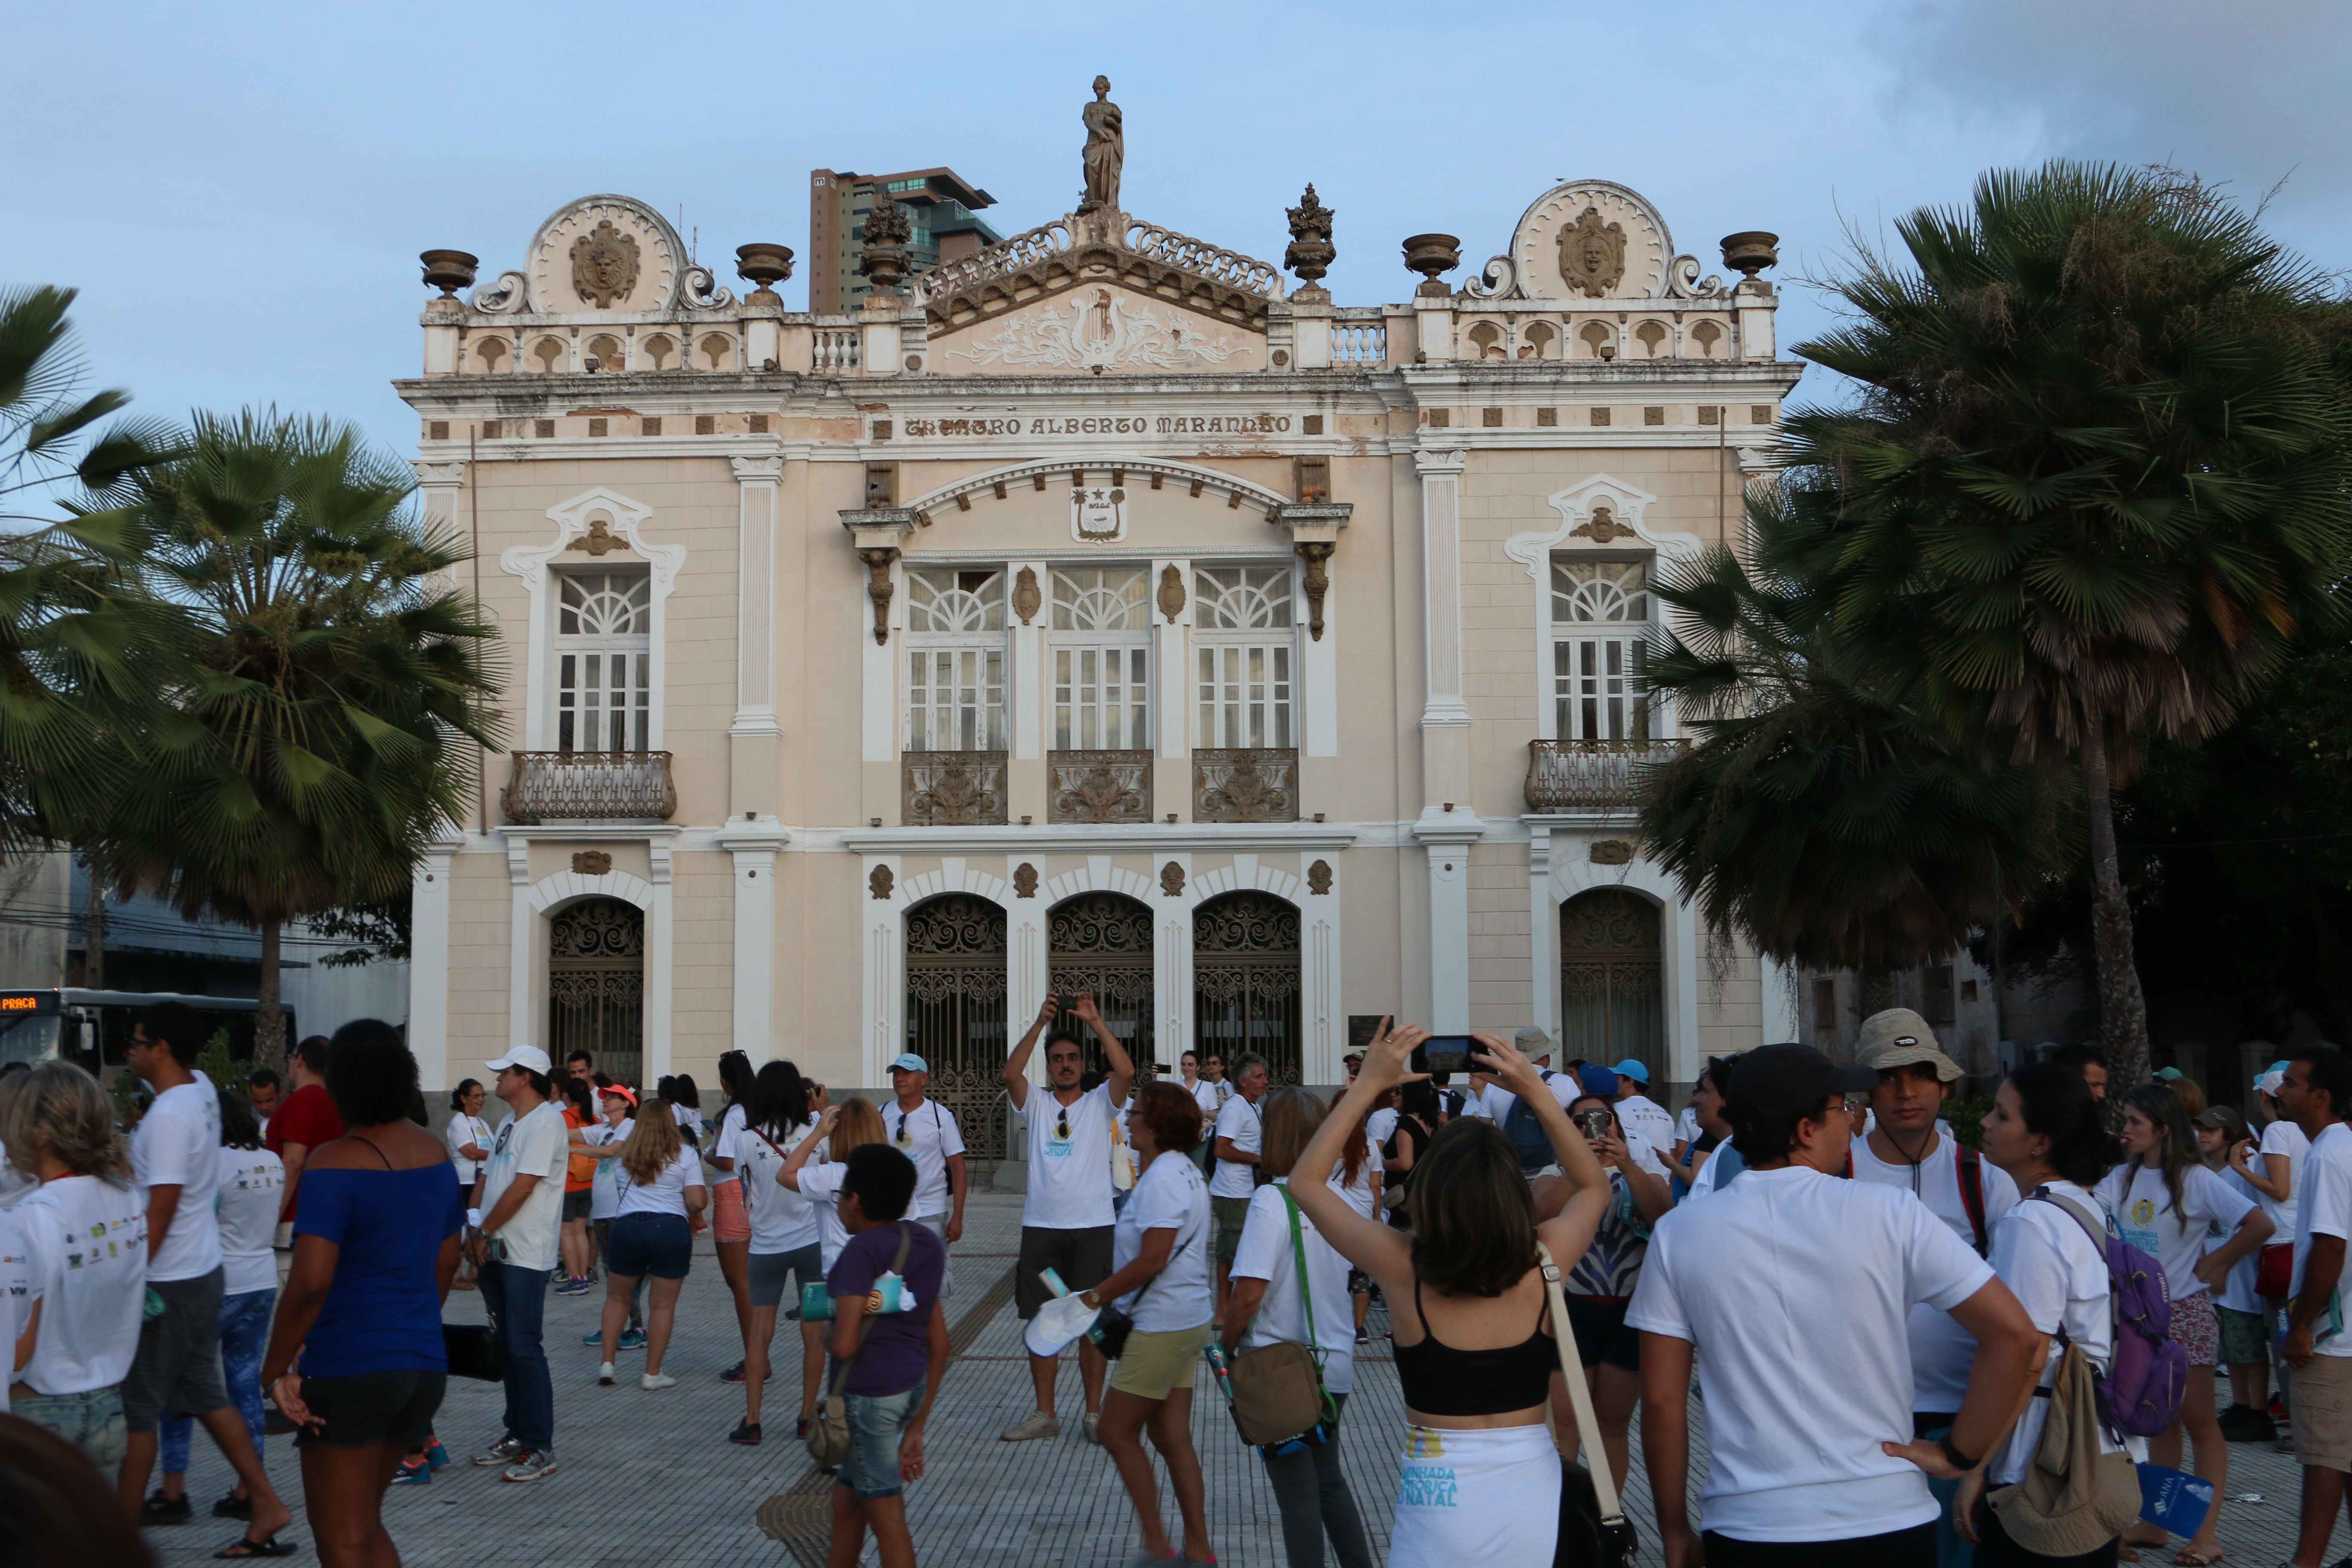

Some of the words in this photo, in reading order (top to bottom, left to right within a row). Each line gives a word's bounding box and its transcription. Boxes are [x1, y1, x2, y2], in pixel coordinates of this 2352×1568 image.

[1030, 417, 1147, 433] ALBERTO
[1406, 1487, 1457, 1507] NATAL
[2159, 1478, 2174, 1498] ANA
